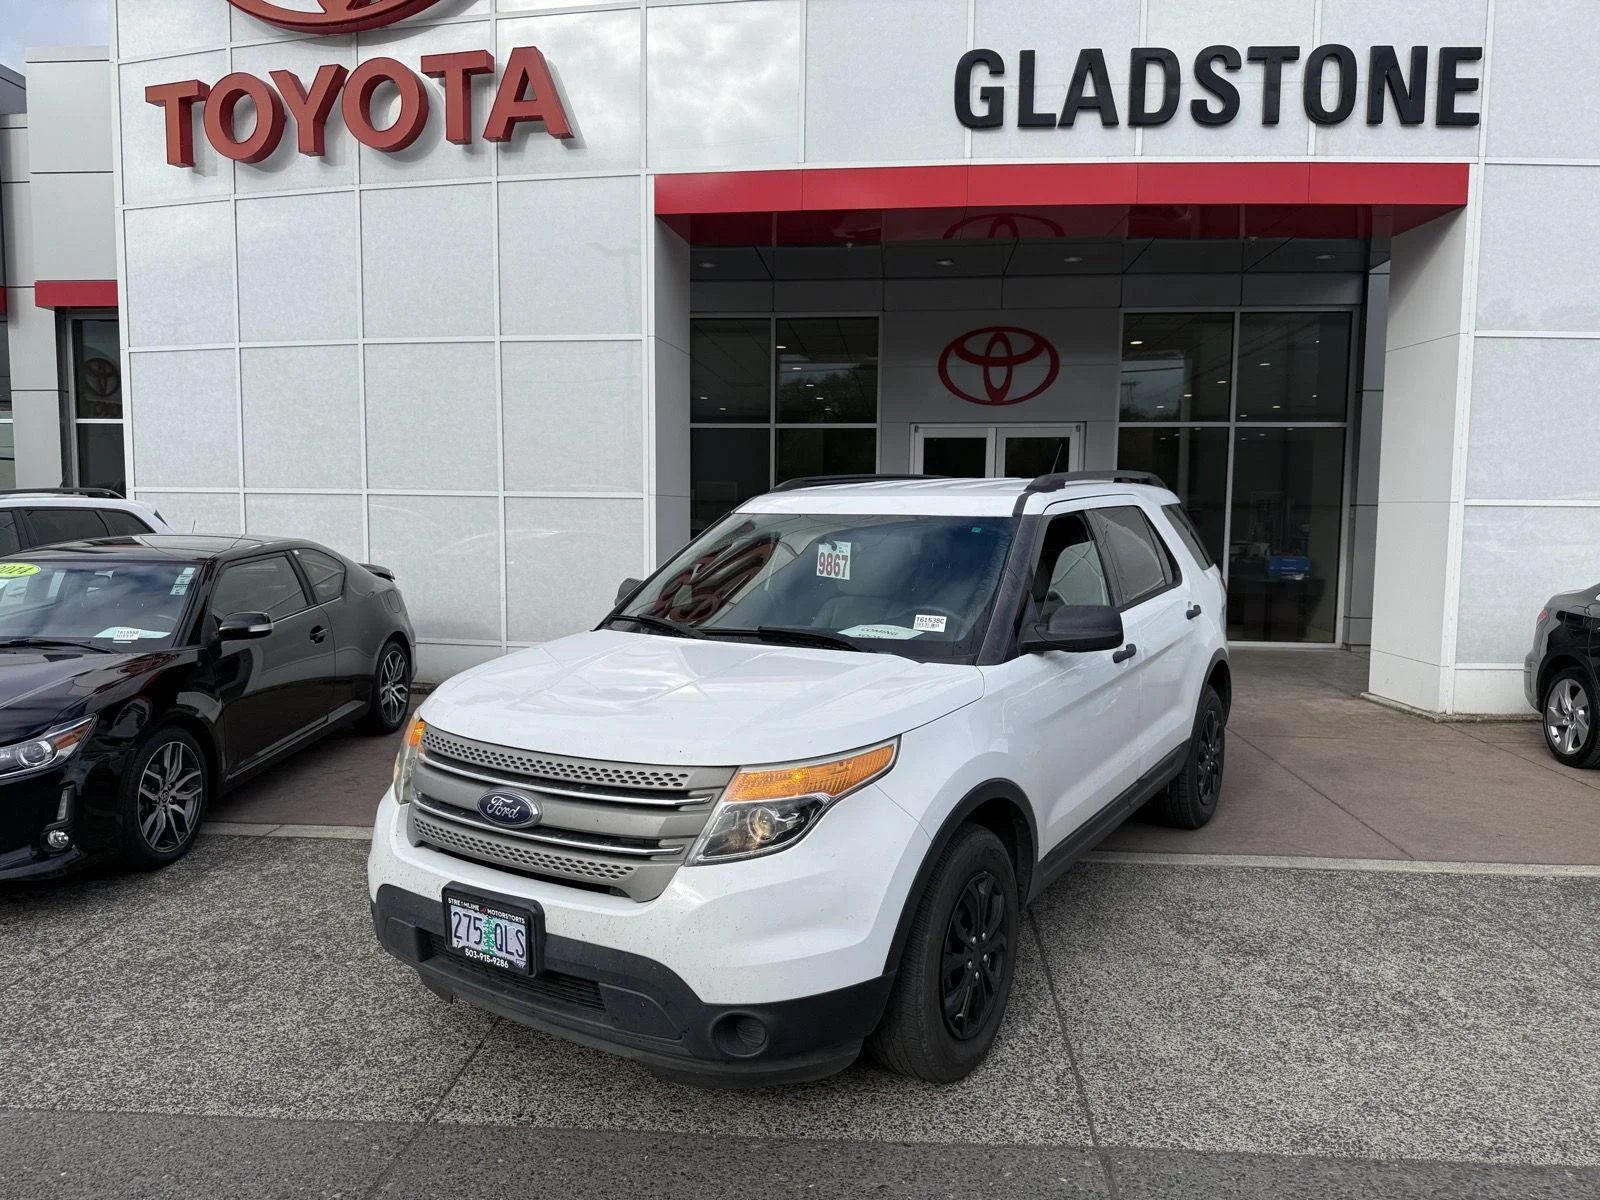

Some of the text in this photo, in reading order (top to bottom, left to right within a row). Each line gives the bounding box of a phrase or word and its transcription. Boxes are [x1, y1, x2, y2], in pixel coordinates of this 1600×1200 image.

[954, 44, 1483, 131] GLADSTONE
[145, 46, 574, 168] TOYOTA
[818, 552, 849, 577] 9867
[487, 796, 521, 818] Ford
[453, 911, 525, 959] 275 QLS
[465, 948, 509, 968] 503-915-9286
